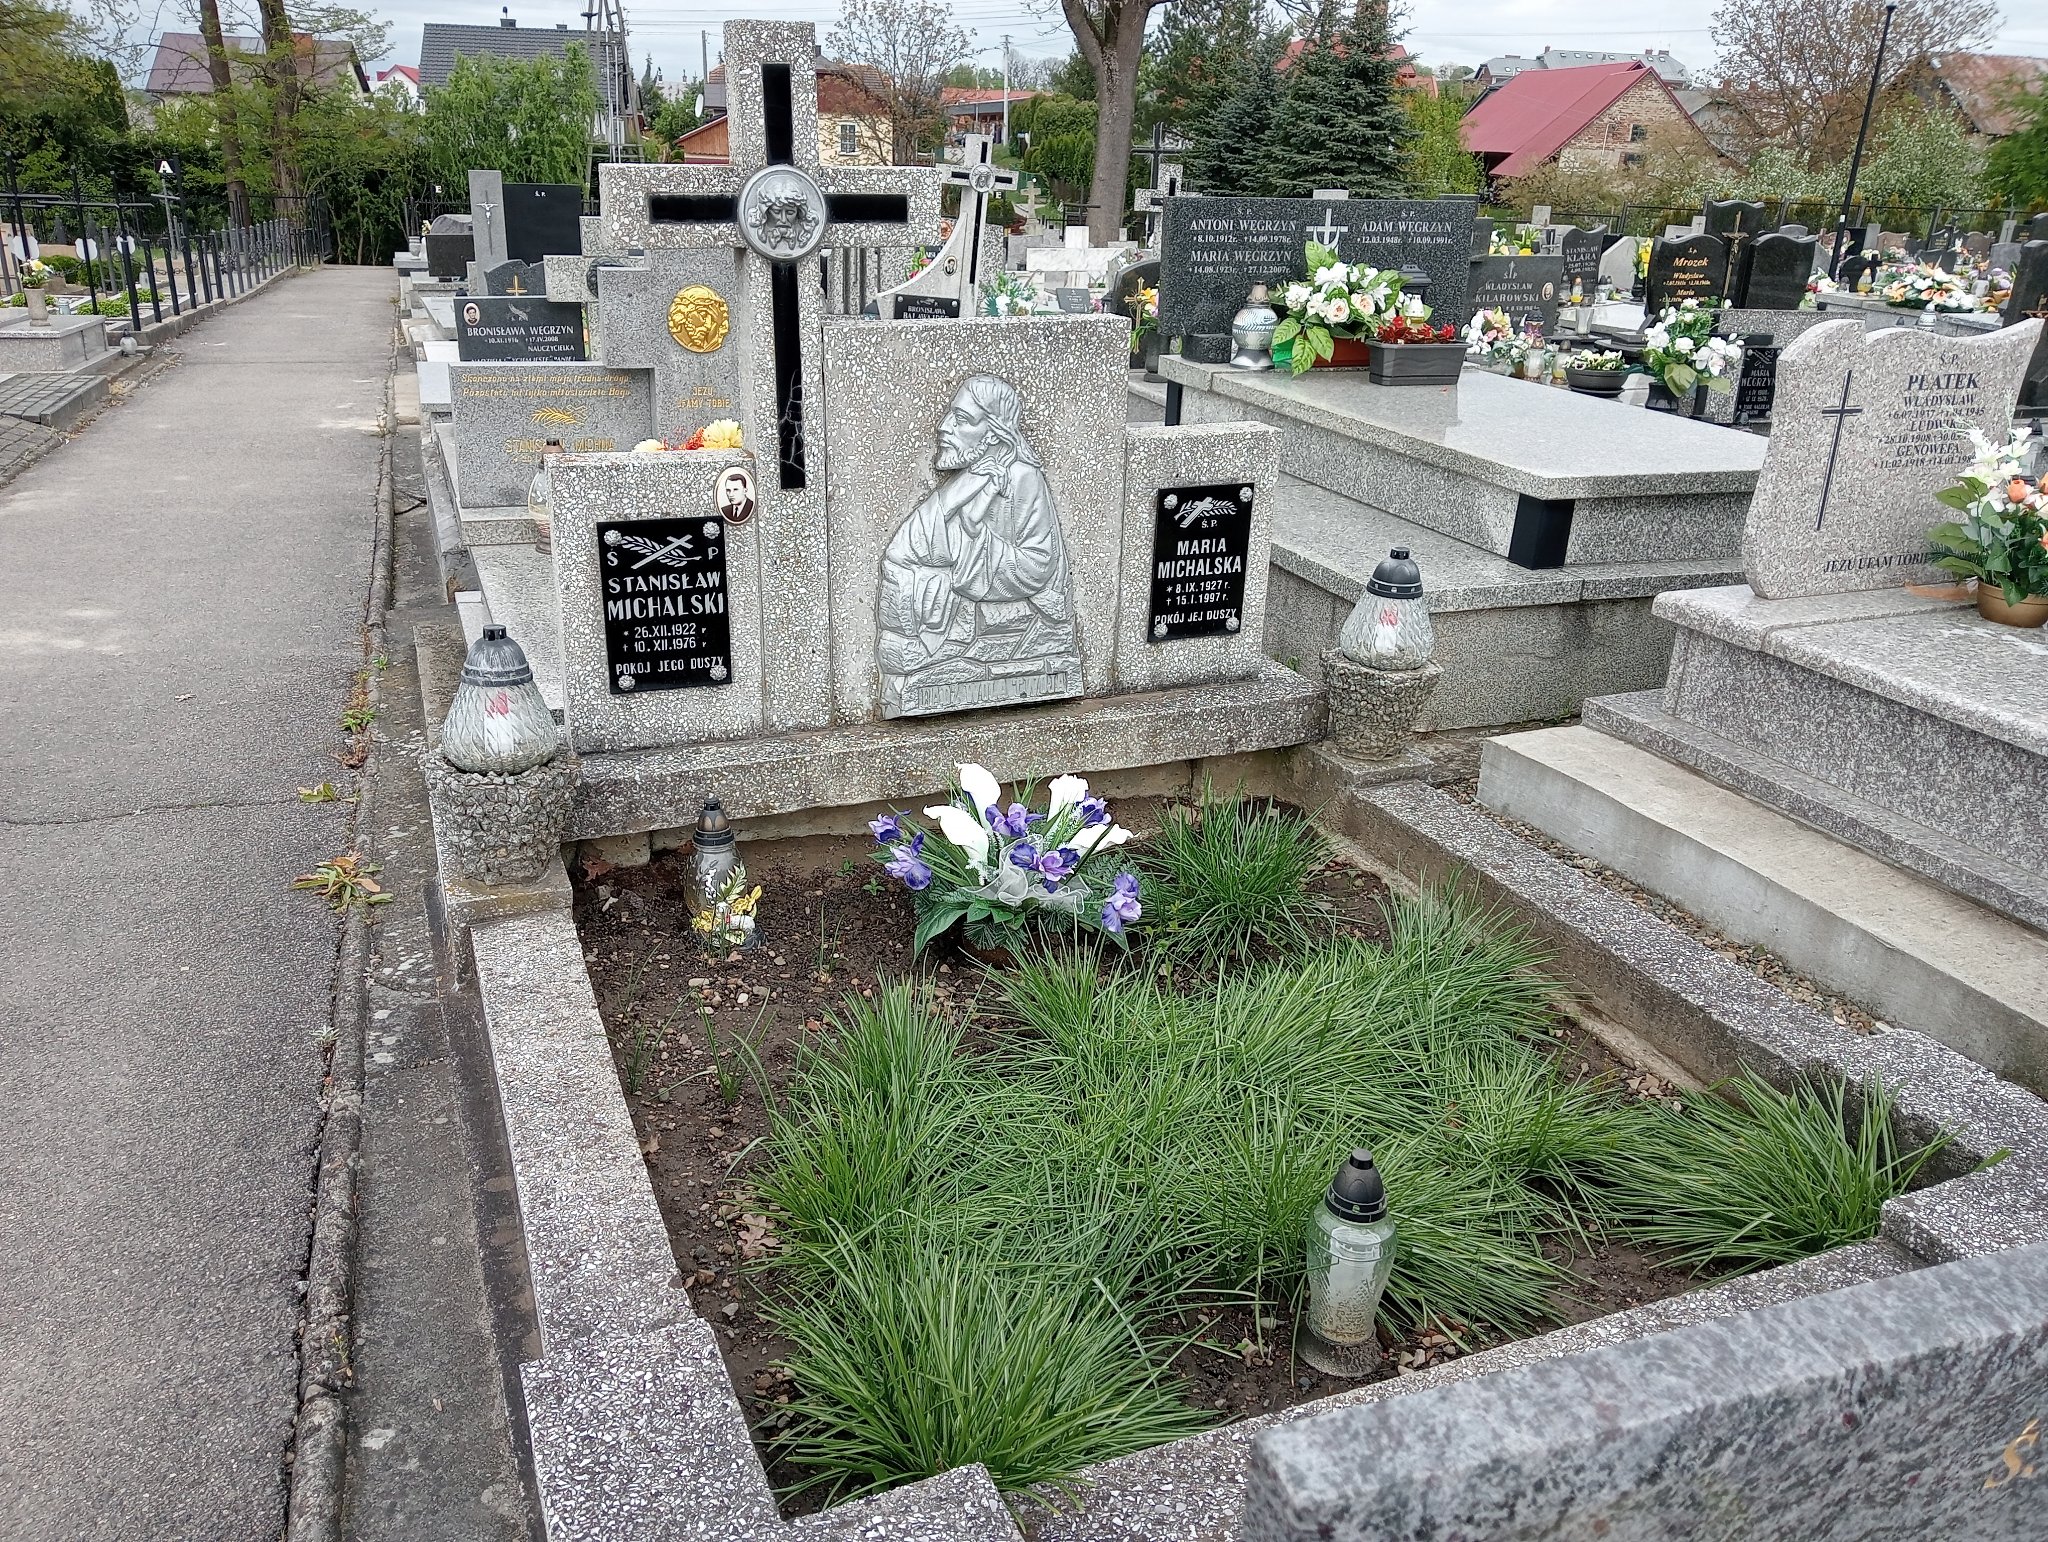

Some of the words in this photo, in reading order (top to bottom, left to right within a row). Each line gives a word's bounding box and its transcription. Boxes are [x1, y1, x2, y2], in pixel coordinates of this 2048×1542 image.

[158, 160, 174, 174] A
[1190, 219, 1234, 231] ANTONI
[1239, 219, 1296, 233] WĘGRZYN
[1361, 221, 1394, 233] ADAM
[1398, 221, 1452, 235] WĘGRZYN
[1191, 250, 1230, 262] MARIA
[1234, 250, 1292, 264] WĘGRZYN
[1673, 257, 1709, 267] Mrozek
[1475, 293, 1540, 303] KILAROWSKI
[467, 326, 526, 336] BRONISŁAWA
[529, 325, 574, 337] WĘGRZYN
[692, 386, 713, 396] JEZU
[708, 547, 719, 560] P
[1177, 537, 1227, 556] MARIA
[1157, 555, 1242, 579] MICHALSKA
[1824, 559, 1855, 573] JEZU
[1858, 556, 1892, 570] UFAM
[608, 571, 720, 594] STANISŁAW
[608, 592, 724, 621] MICHALSKI
[1154, 611, 1185, 625] POKÓJ
[1187, 611, 1204, 622] JEJ
[1206, 608, 1237, 620] DUSZY
[690, 656, 724, 670] DUSZY
